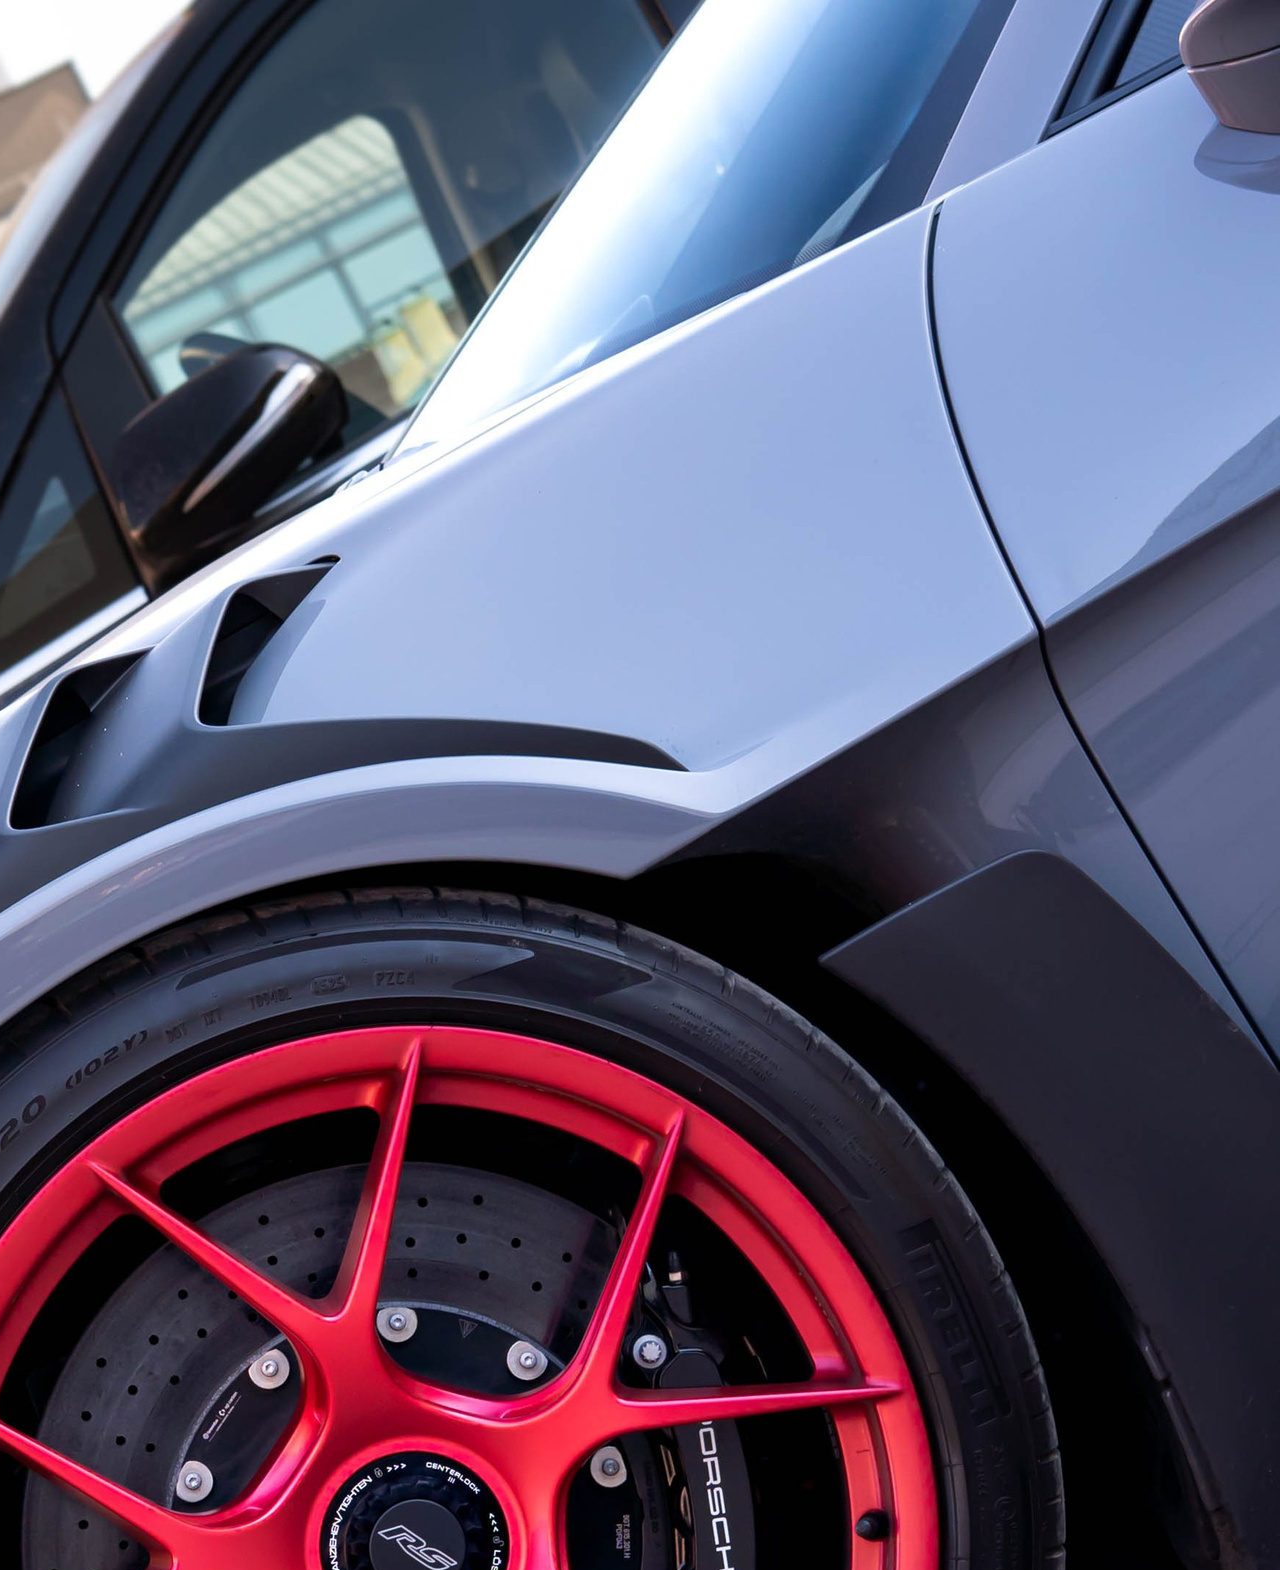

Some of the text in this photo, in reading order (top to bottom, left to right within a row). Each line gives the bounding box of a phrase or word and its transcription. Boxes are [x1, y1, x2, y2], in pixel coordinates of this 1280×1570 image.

[65, 1030, 149, 1091] (102Y)
[425, 1461, 481, 1495] CENTERLOCK
[377, 1524, 458, 1570] RS
